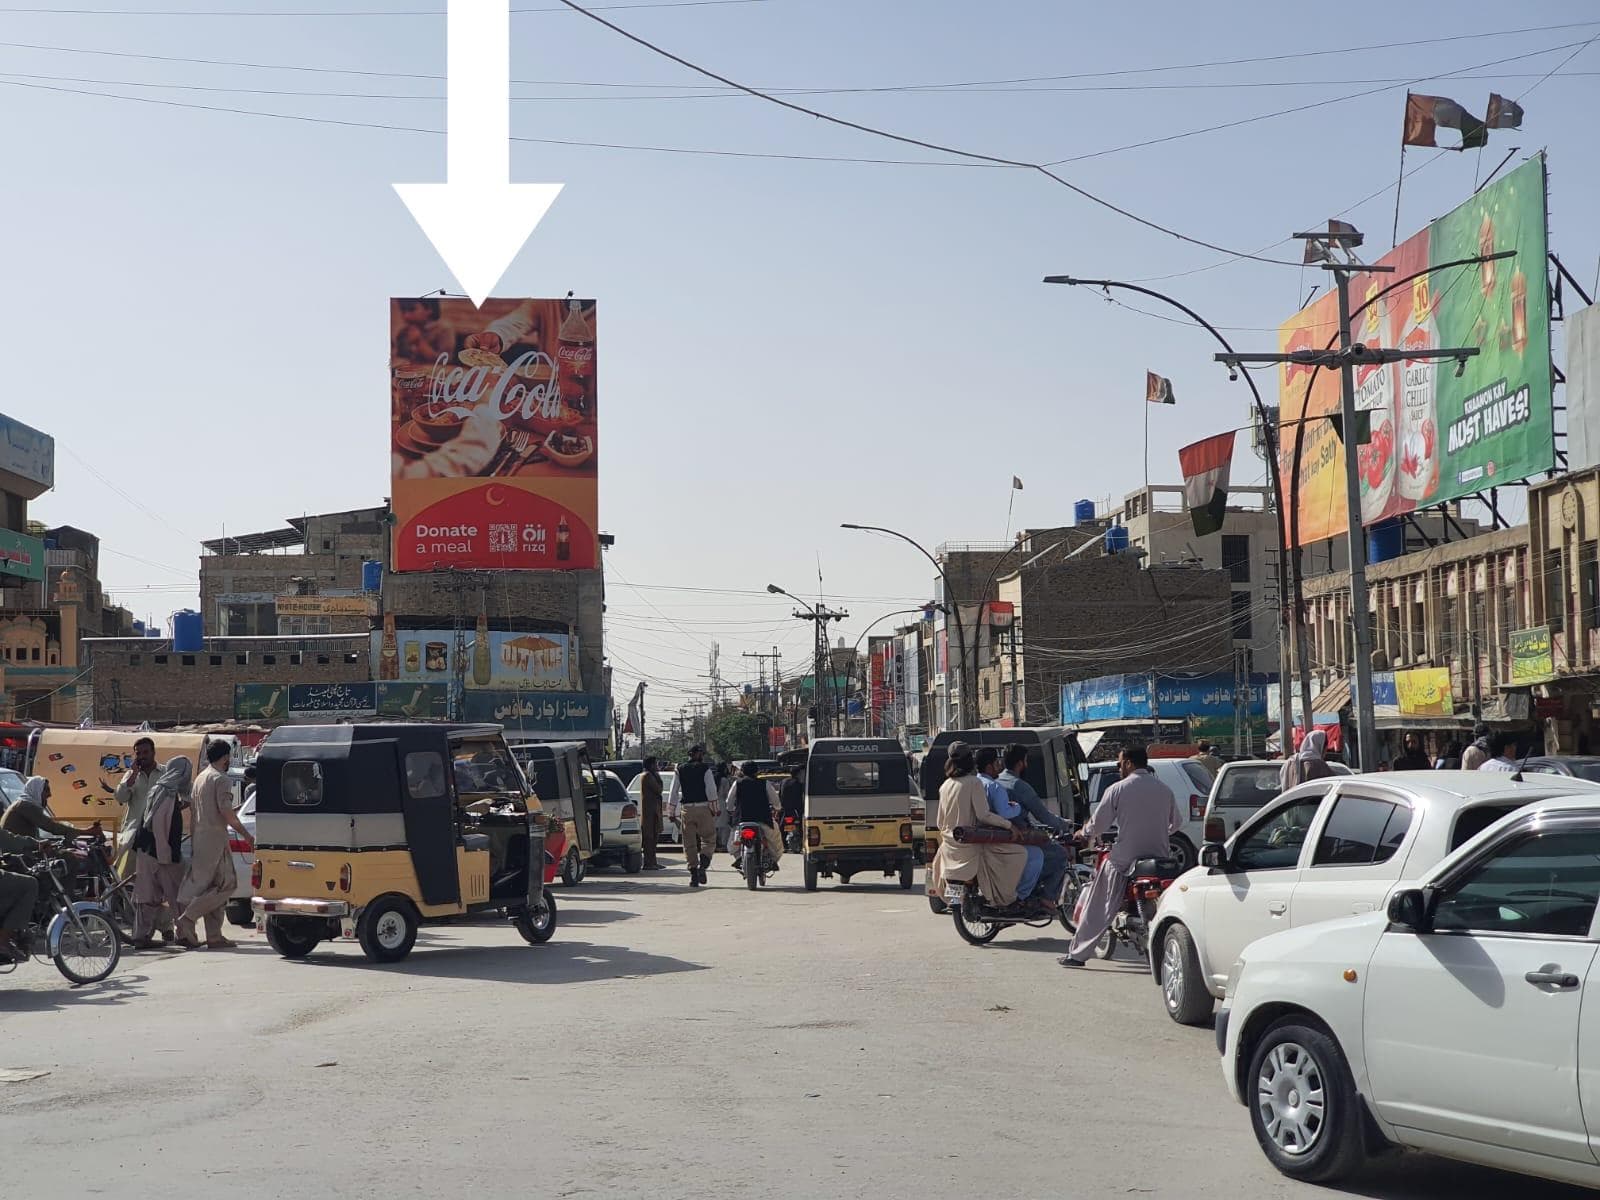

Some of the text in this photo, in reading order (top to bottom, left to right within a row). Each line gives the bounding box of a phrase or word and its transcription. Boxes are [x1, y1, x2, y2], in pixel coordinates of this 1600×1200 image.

[1405, 366, 1430, 387] GARLIC
[1448, 388, 1529, 452] MUST HAVES!
[416, 525, 478, 538] Donate
[416, 540, 472, 554] a meal
